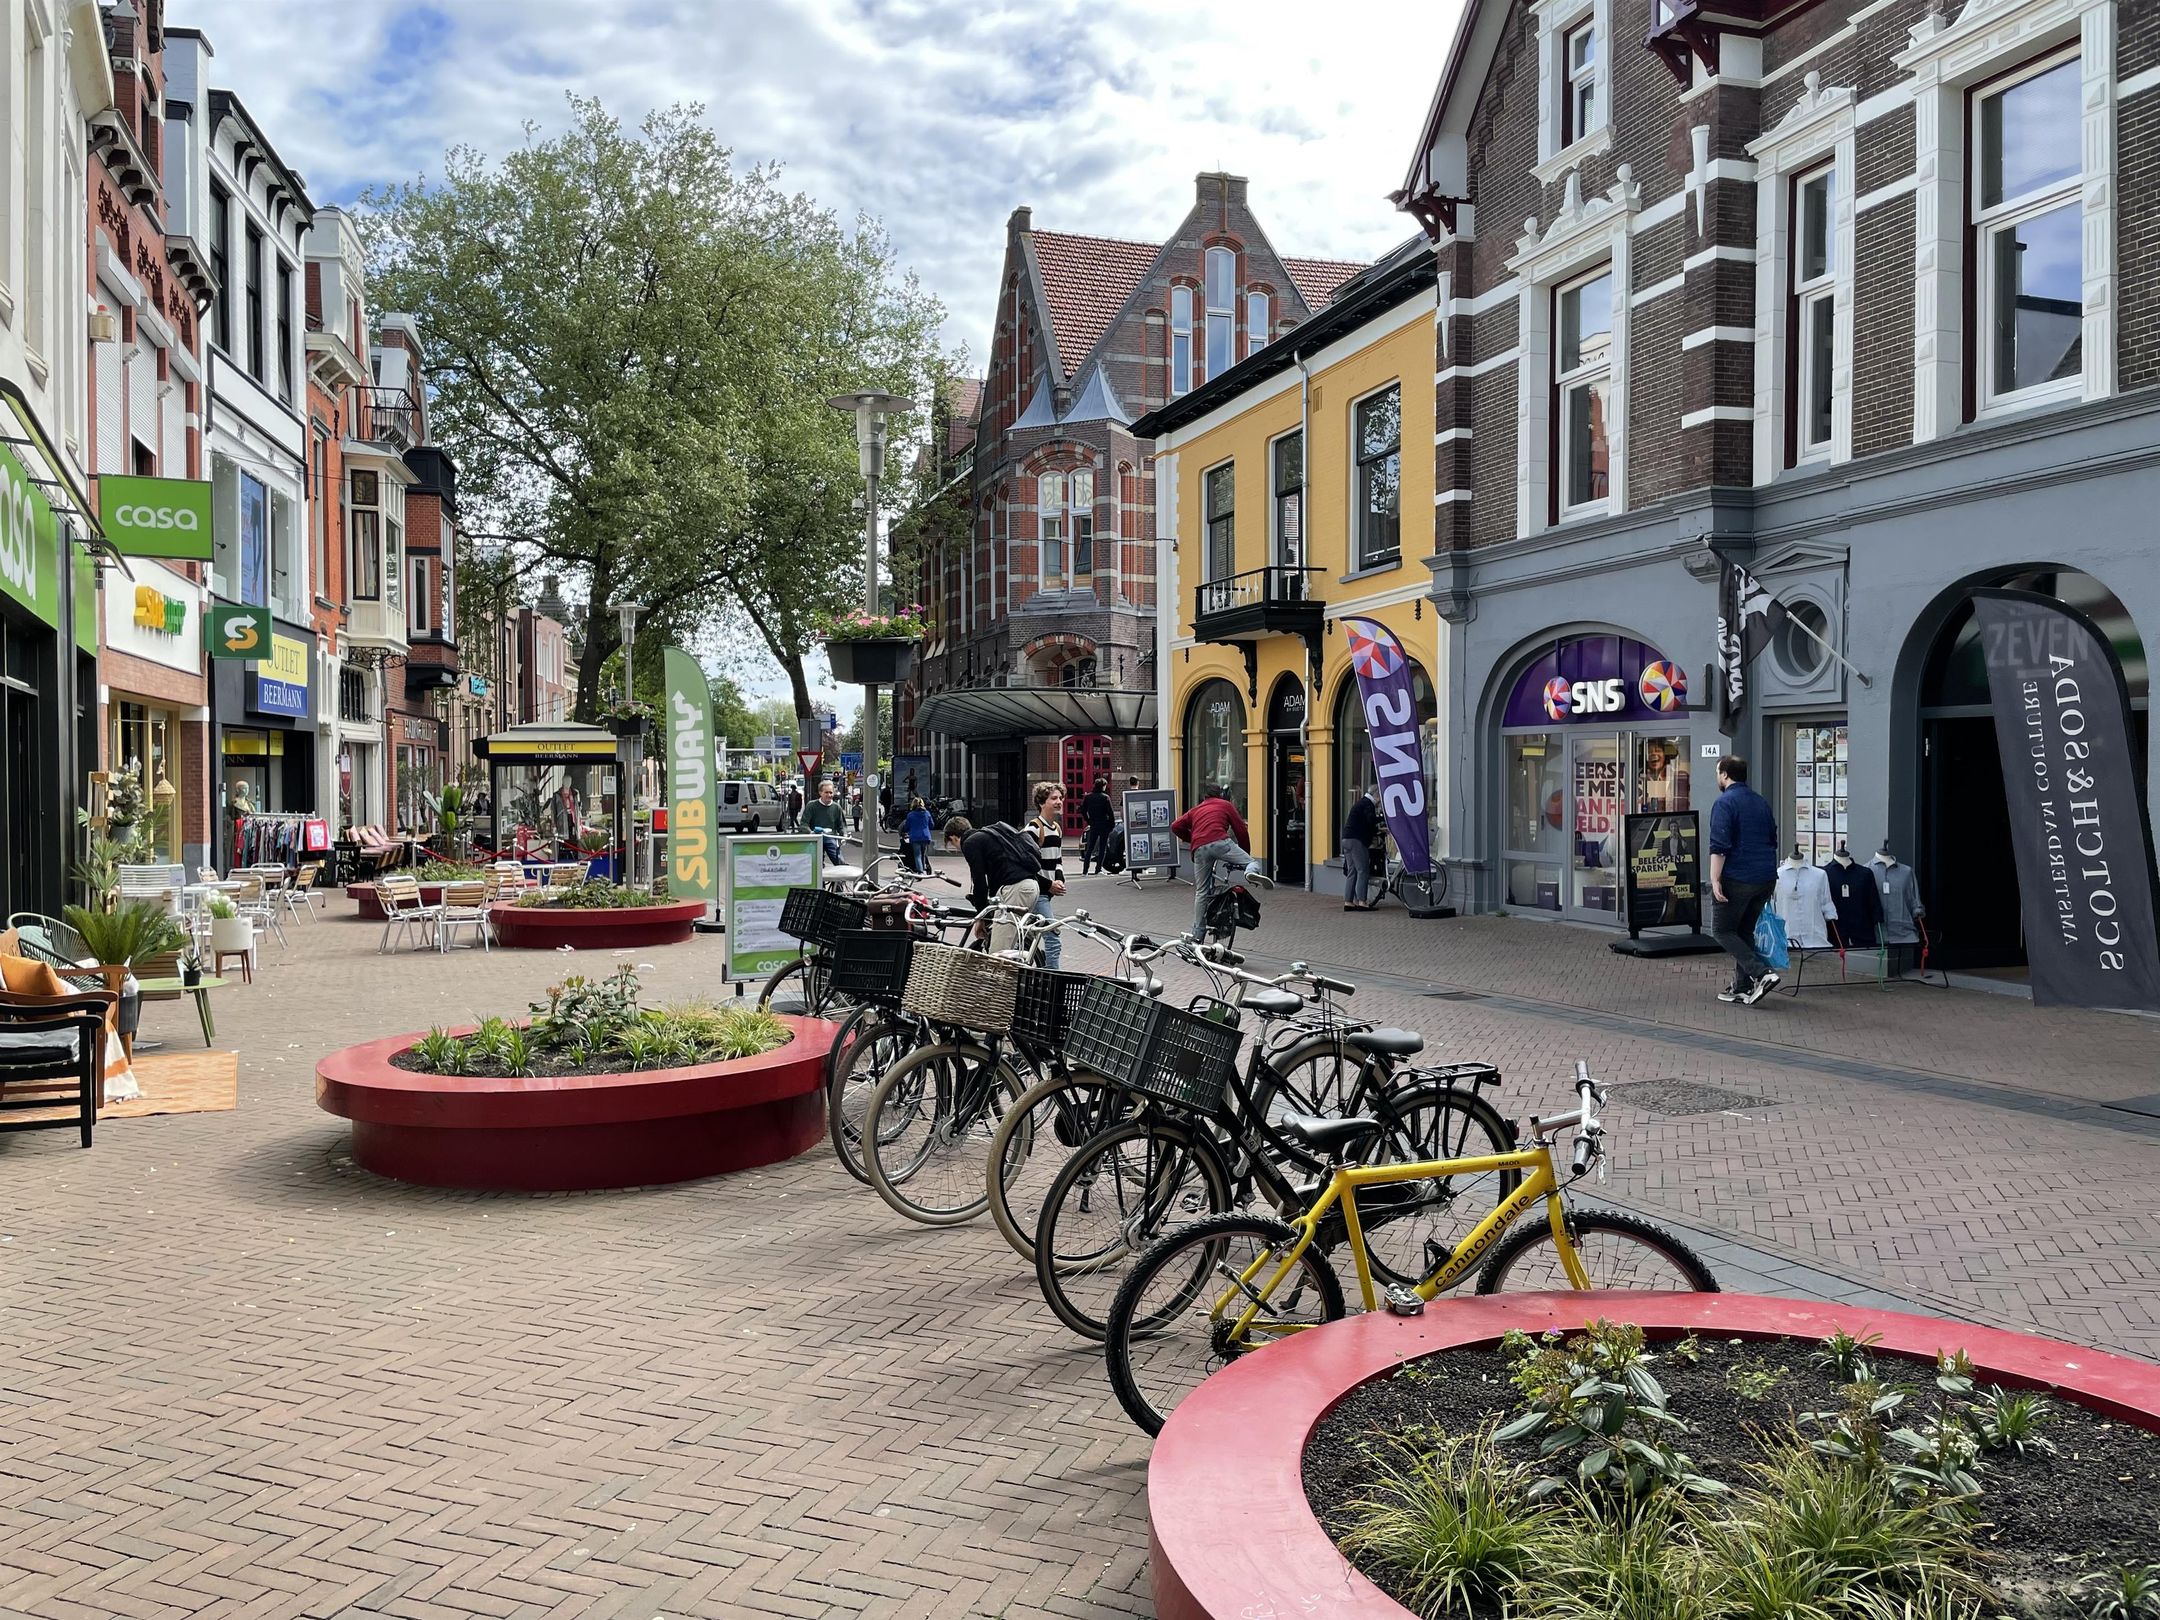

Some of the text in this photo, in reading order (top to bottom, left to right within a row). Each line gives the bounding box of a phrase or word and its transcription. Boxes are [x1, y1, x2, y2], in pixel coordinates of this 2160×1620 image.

[115, 505, 198, 530] casa
[267, 644, 300, 675] OUTLET
[263, 683, 302, 709] BEERMANN
[1210, 701, 1230, 712] ADAM
[1571, 679, 1625, 714] SNS
[537, 743, 576, 751] OUTLET
[1705, 746, 1717, 755] 14A
[671, 690, 712, 890] SUBWAY
[1631, 864, 1668, 874] SPAREN?
[1638, 854, 1685, 865] BELEGGEN?
[1434, 1195, 1530, 1288] cannondale
